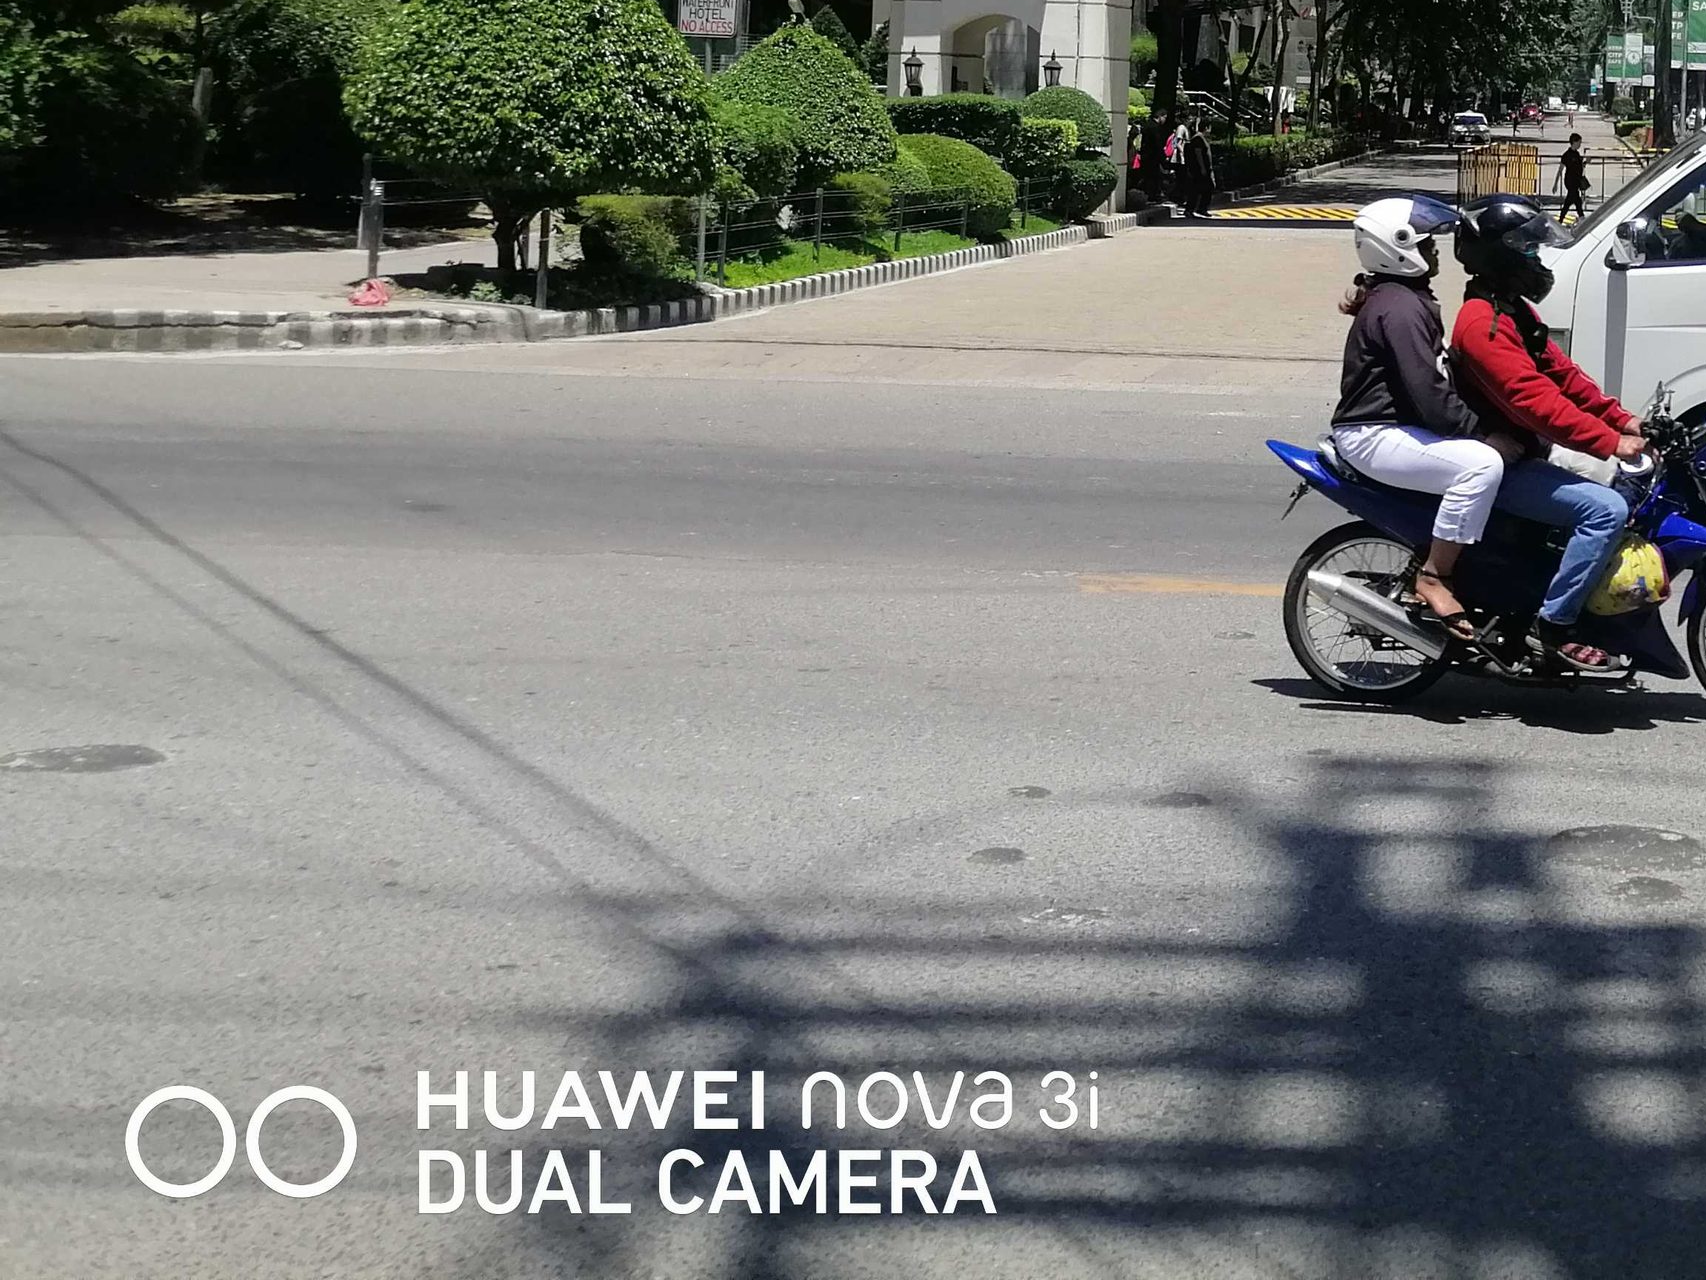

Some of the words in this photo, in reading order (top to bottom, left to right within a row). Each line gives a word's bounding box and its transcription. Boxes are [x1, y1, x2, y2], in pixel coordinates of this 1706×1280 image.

[689, 8, 726, 20] HOTEL
[1672, 11, 1684, 19] EP
[681, 20, 697, 32] NO
[699, 21, 733, 33] ACCESS
[1671, 21, 1683, 30] TP
[1671, 32, 1682, 40] FE
